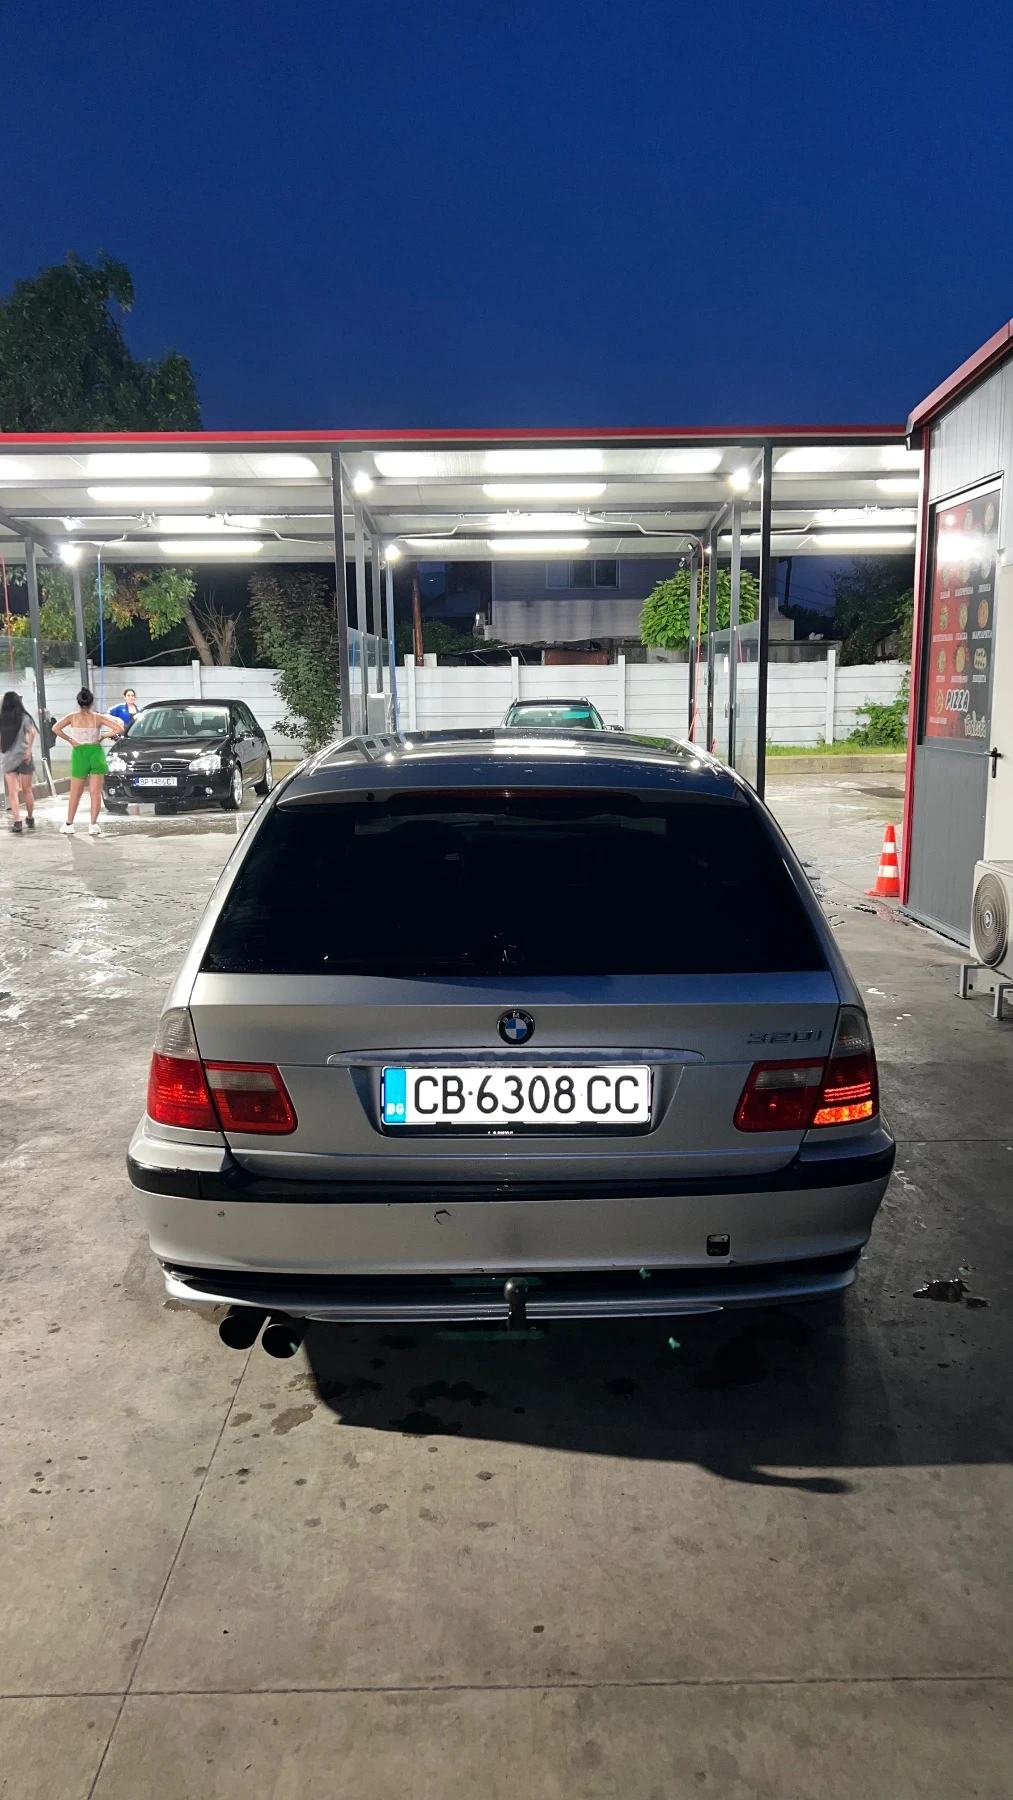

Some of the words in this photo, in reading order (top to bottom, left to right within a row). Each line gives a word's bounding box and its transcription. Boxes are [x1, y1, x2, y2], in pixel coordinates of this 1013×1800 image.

[945, 689, 970, 712] PIZZA
[501, 1012, 531, 1024] BMW
[586, 1075, 639, 1114] CC
[386, 1102, 405, 1116] BG
